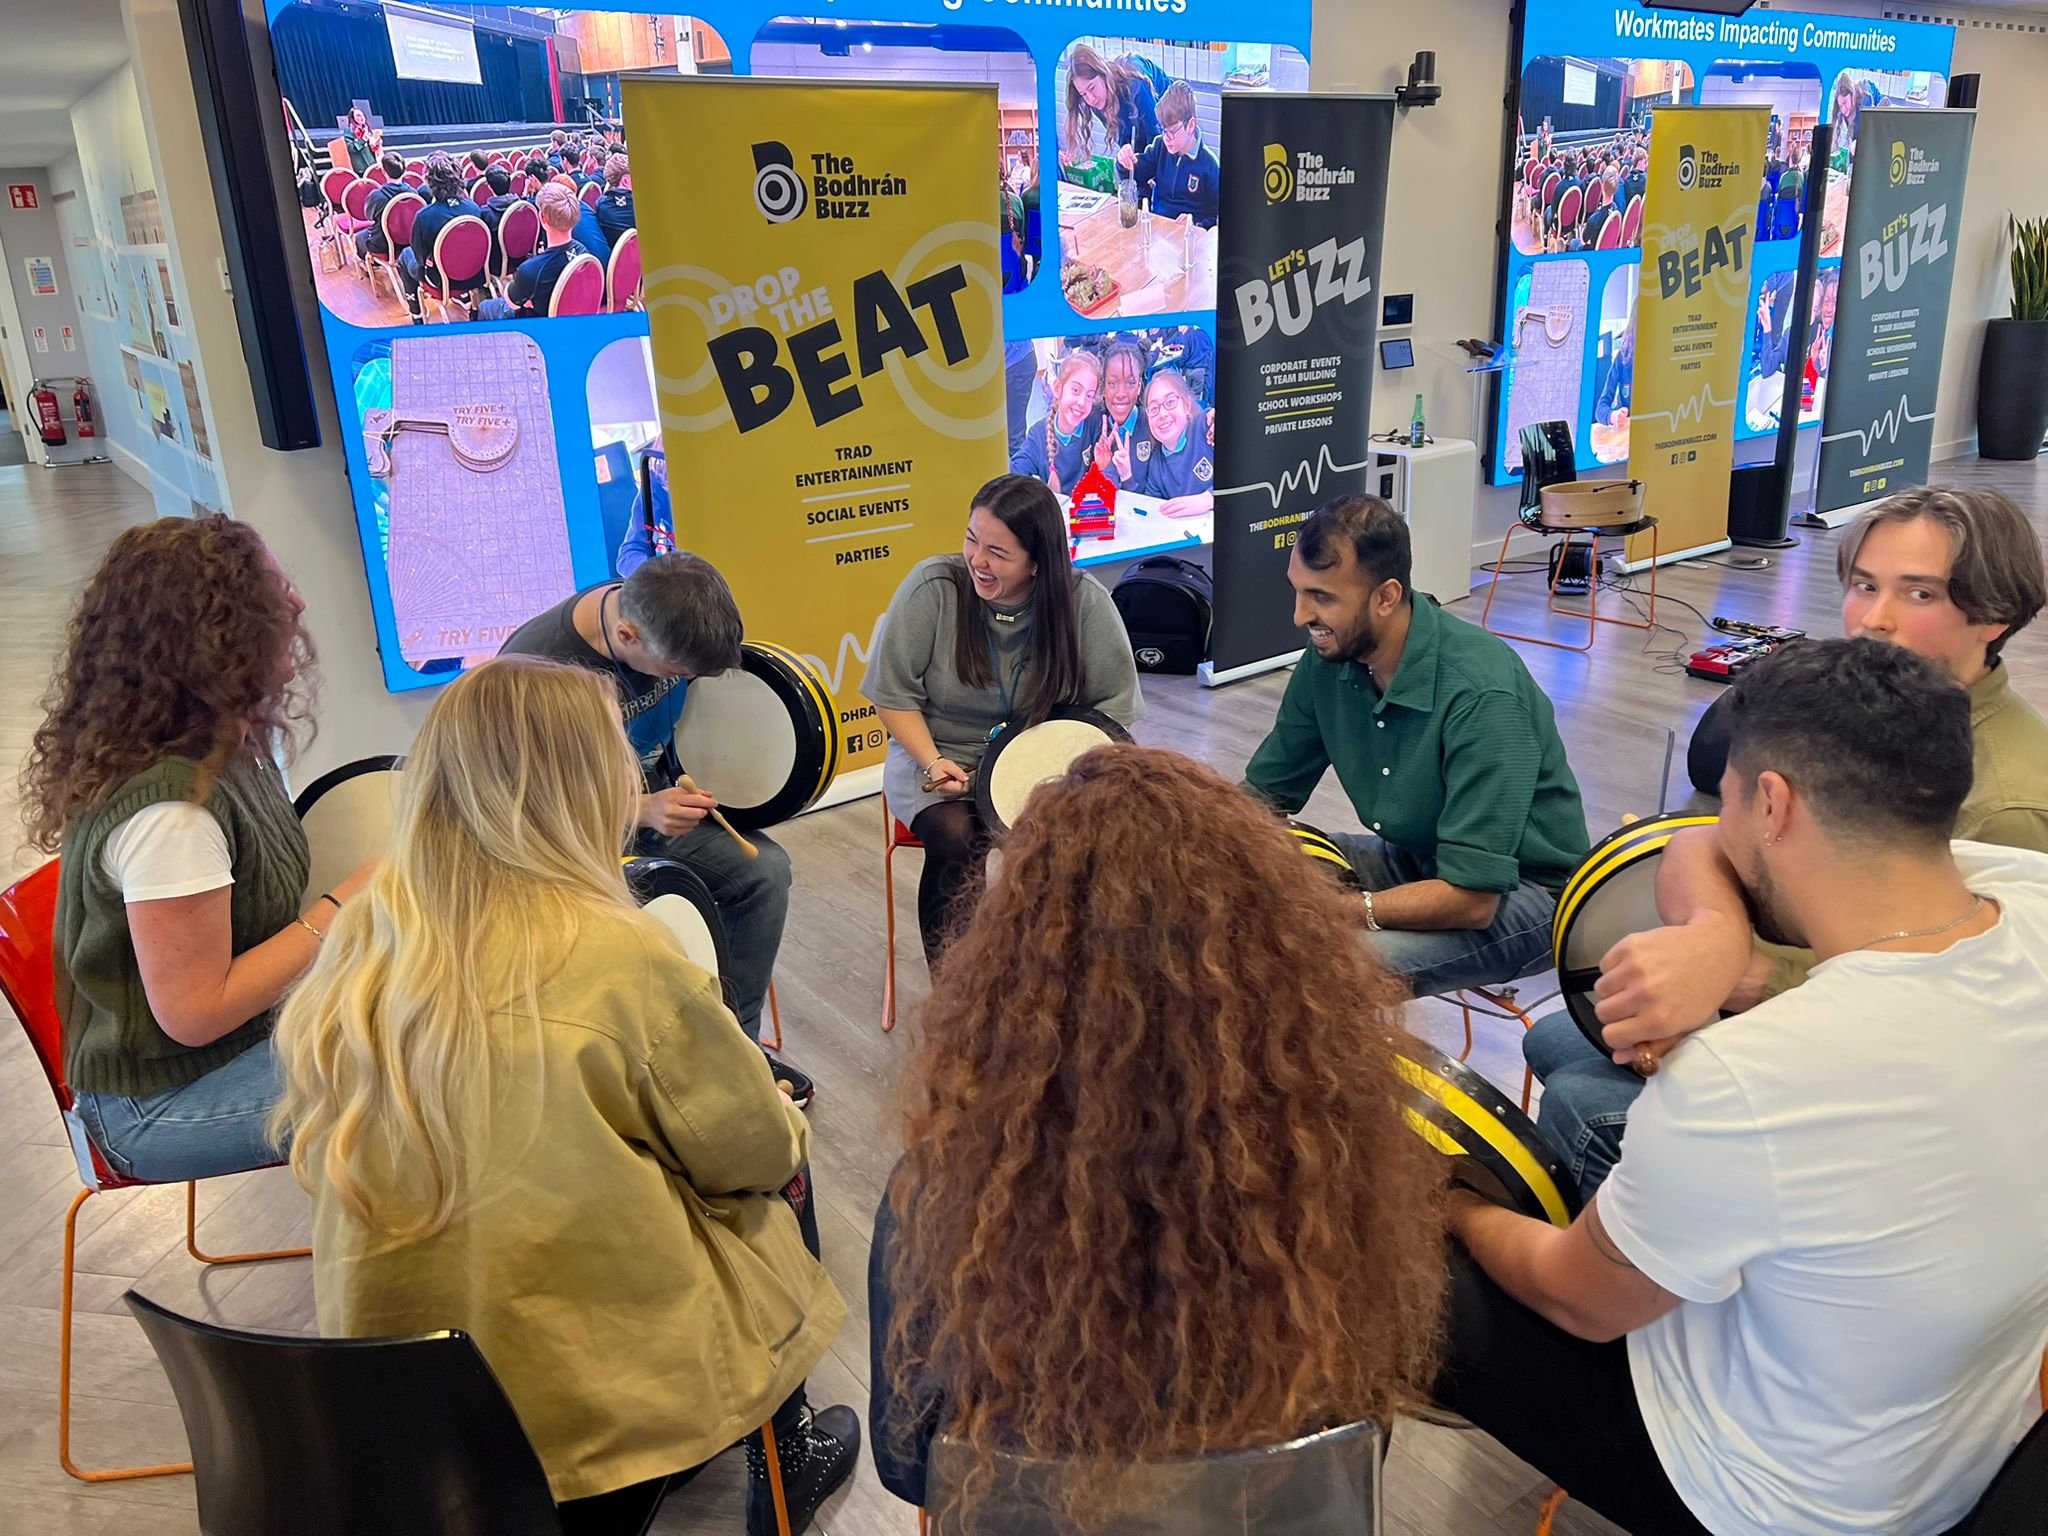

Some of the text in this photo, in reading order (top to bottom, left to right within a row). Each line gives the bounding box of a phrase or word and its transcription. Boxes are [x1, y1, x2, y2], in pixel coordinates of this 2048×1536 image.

[1615, 9, 1896, 52] Workmates Impacting Communities
[811, 153, 854, 174] The
[1297, 152, 1323, 168] The
[1701, 151, 1718, 163] The
[1909, 148, 1924, 160] The
[1296, 167, 1355, 185] Bodhrán
[1700, 162, 1740, 175] Bodhrán
[814, 173, 907, 196] Bodhrán
[1699, 177, 1722, 188] Buzz
[1296, 186, 1330, 201] Buzz
[815, 198, 870, 219] Buzz
[1882, 213, 1908, 242] LET'S
[1658, 223, 1746, 300] BEAT
[1860, 203, 1948, 300] BUZZ
[1268, 249, 1306, 281] LET'S
[708, 267, 800, 326] DROP
[1235, 237, 1371, 346] BUZZ
[770, 286, 833, 333] THE
[707, 264, 969, 434] BEAT
[1260, 356, 1341, 374] CORPORATE EVENTS
[1265, 369, 1337, 386] & TEAM BUILDING
[475, 405, 497, 413] FIVE
[1258, 392, 1342, 412] SCHOOL WORKSHOPS
[456, 416, 475, 425] TRY
[478, 417, 501, 426] FIVE
[1265, 416, 1333, 435] PRIVATE LESSONS
[835, 445, 873, 460] TRAD
[795, 460, 913, 487] ENTERTAINMENT
[807, 499, 909, 525] SOCIAL EVENTS
[835, 545, 890, 565] PARTIES
[439, 629, 472, 646] TRY
